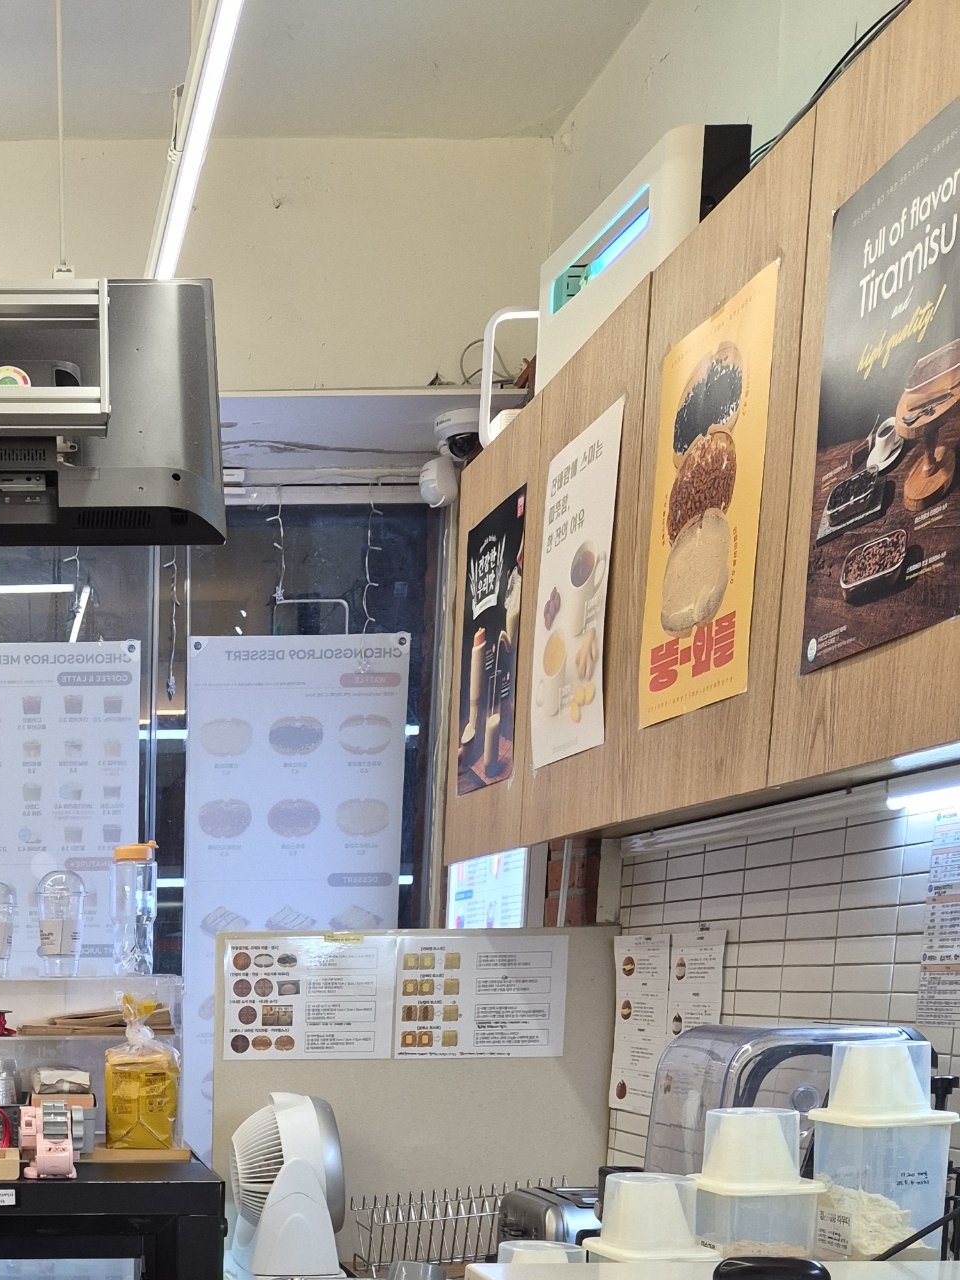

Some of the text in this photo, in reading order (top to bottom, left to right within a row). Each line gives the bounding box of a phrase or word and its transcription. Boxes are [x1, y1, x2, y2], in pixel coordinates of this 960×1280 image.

[864, 169, 960, 269] full of flavor
[859, 213, 958, 318] Tiramisu
[856, 330, 888, 381] high
[579, 439, 604, 473] 스미는
[546, 508, 585, 554] 한 잔의 여유
